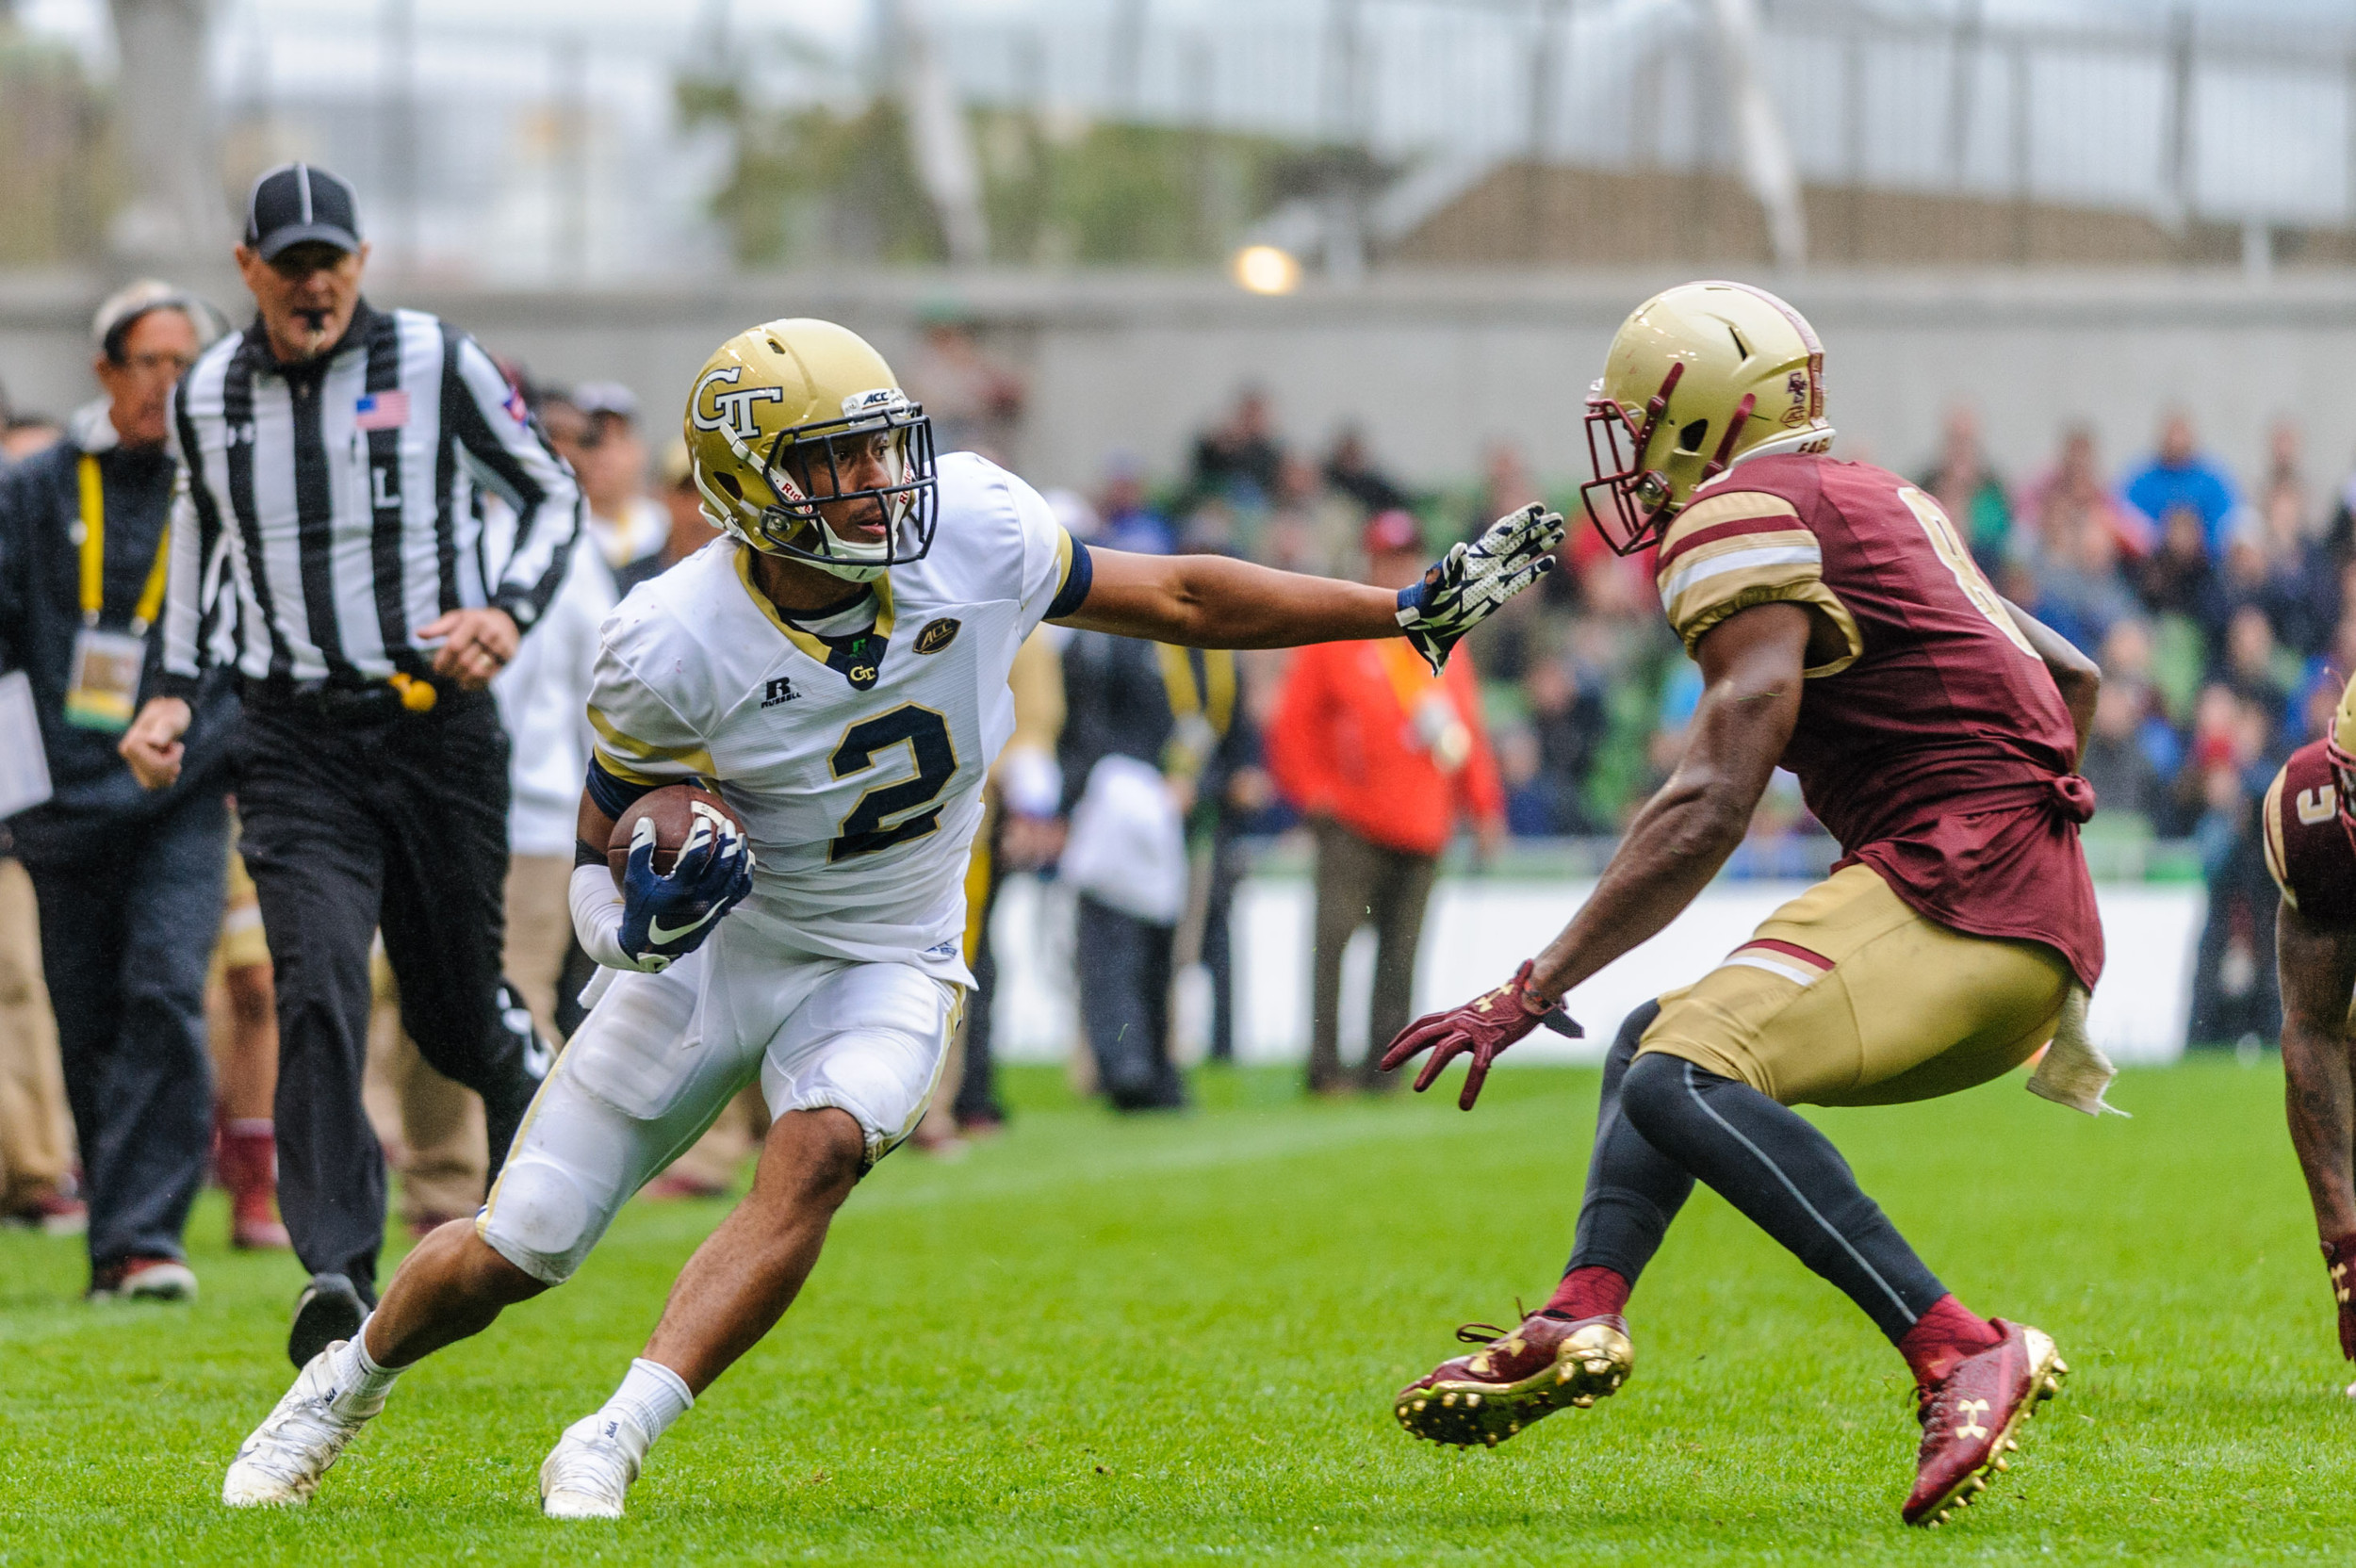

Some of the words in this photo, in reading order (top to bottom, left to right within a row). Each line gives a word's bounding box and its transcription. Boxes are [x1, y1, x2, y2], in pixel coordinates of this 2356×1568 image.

[863, 392, 889, 405] ACC
[373, 467, 401, 507] L
[921, 621, 954, 650] ACC
[765, 677, 791, 700] R
[826, 699, 960, 865] 2
